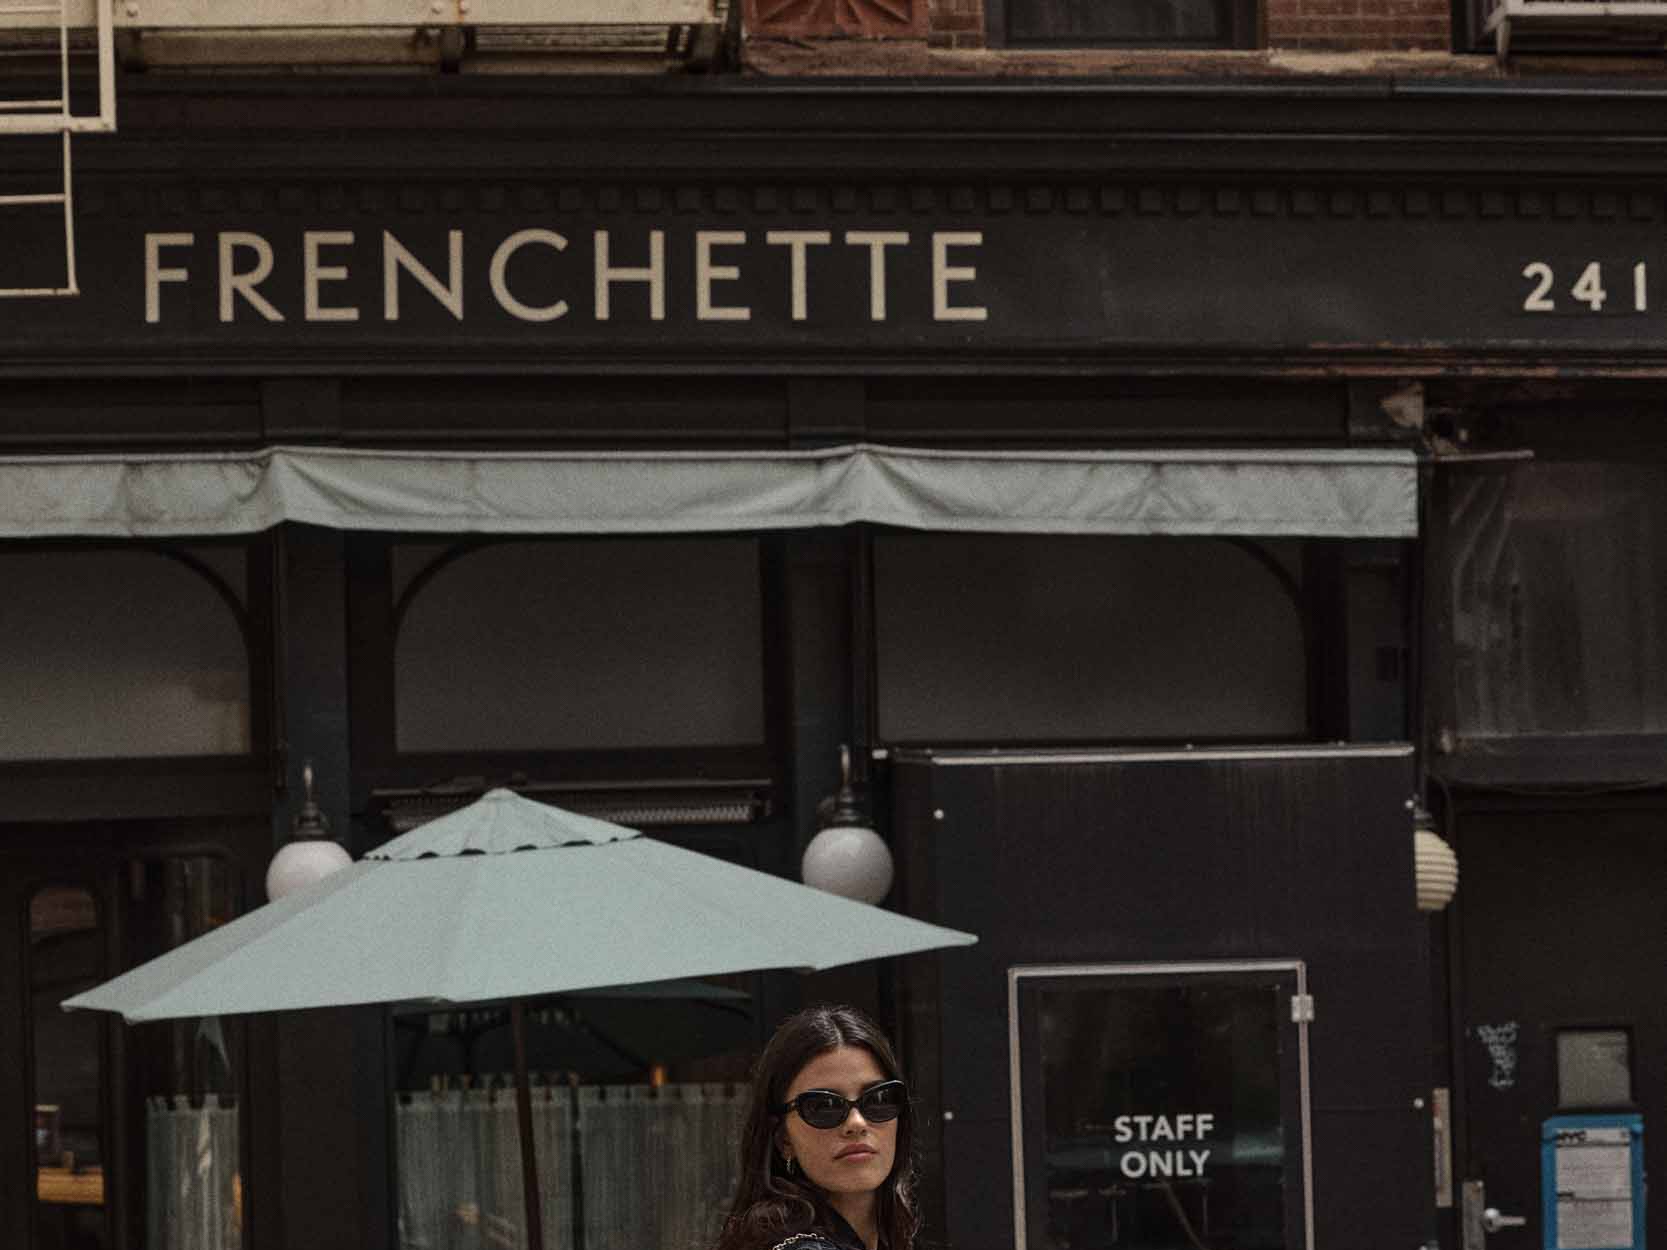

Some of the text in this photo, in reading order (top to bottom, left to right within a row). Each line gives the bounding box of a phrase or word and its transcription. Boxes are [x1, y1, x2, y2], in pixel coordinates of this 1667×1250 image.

[145, 229, 988, 323] FRENCHETTE
[1522, 261, 1647, 311] 241
[1114, 1113, 1214, 1142] STAFF
[1120, 1150, 1211, 1178] ONLY
